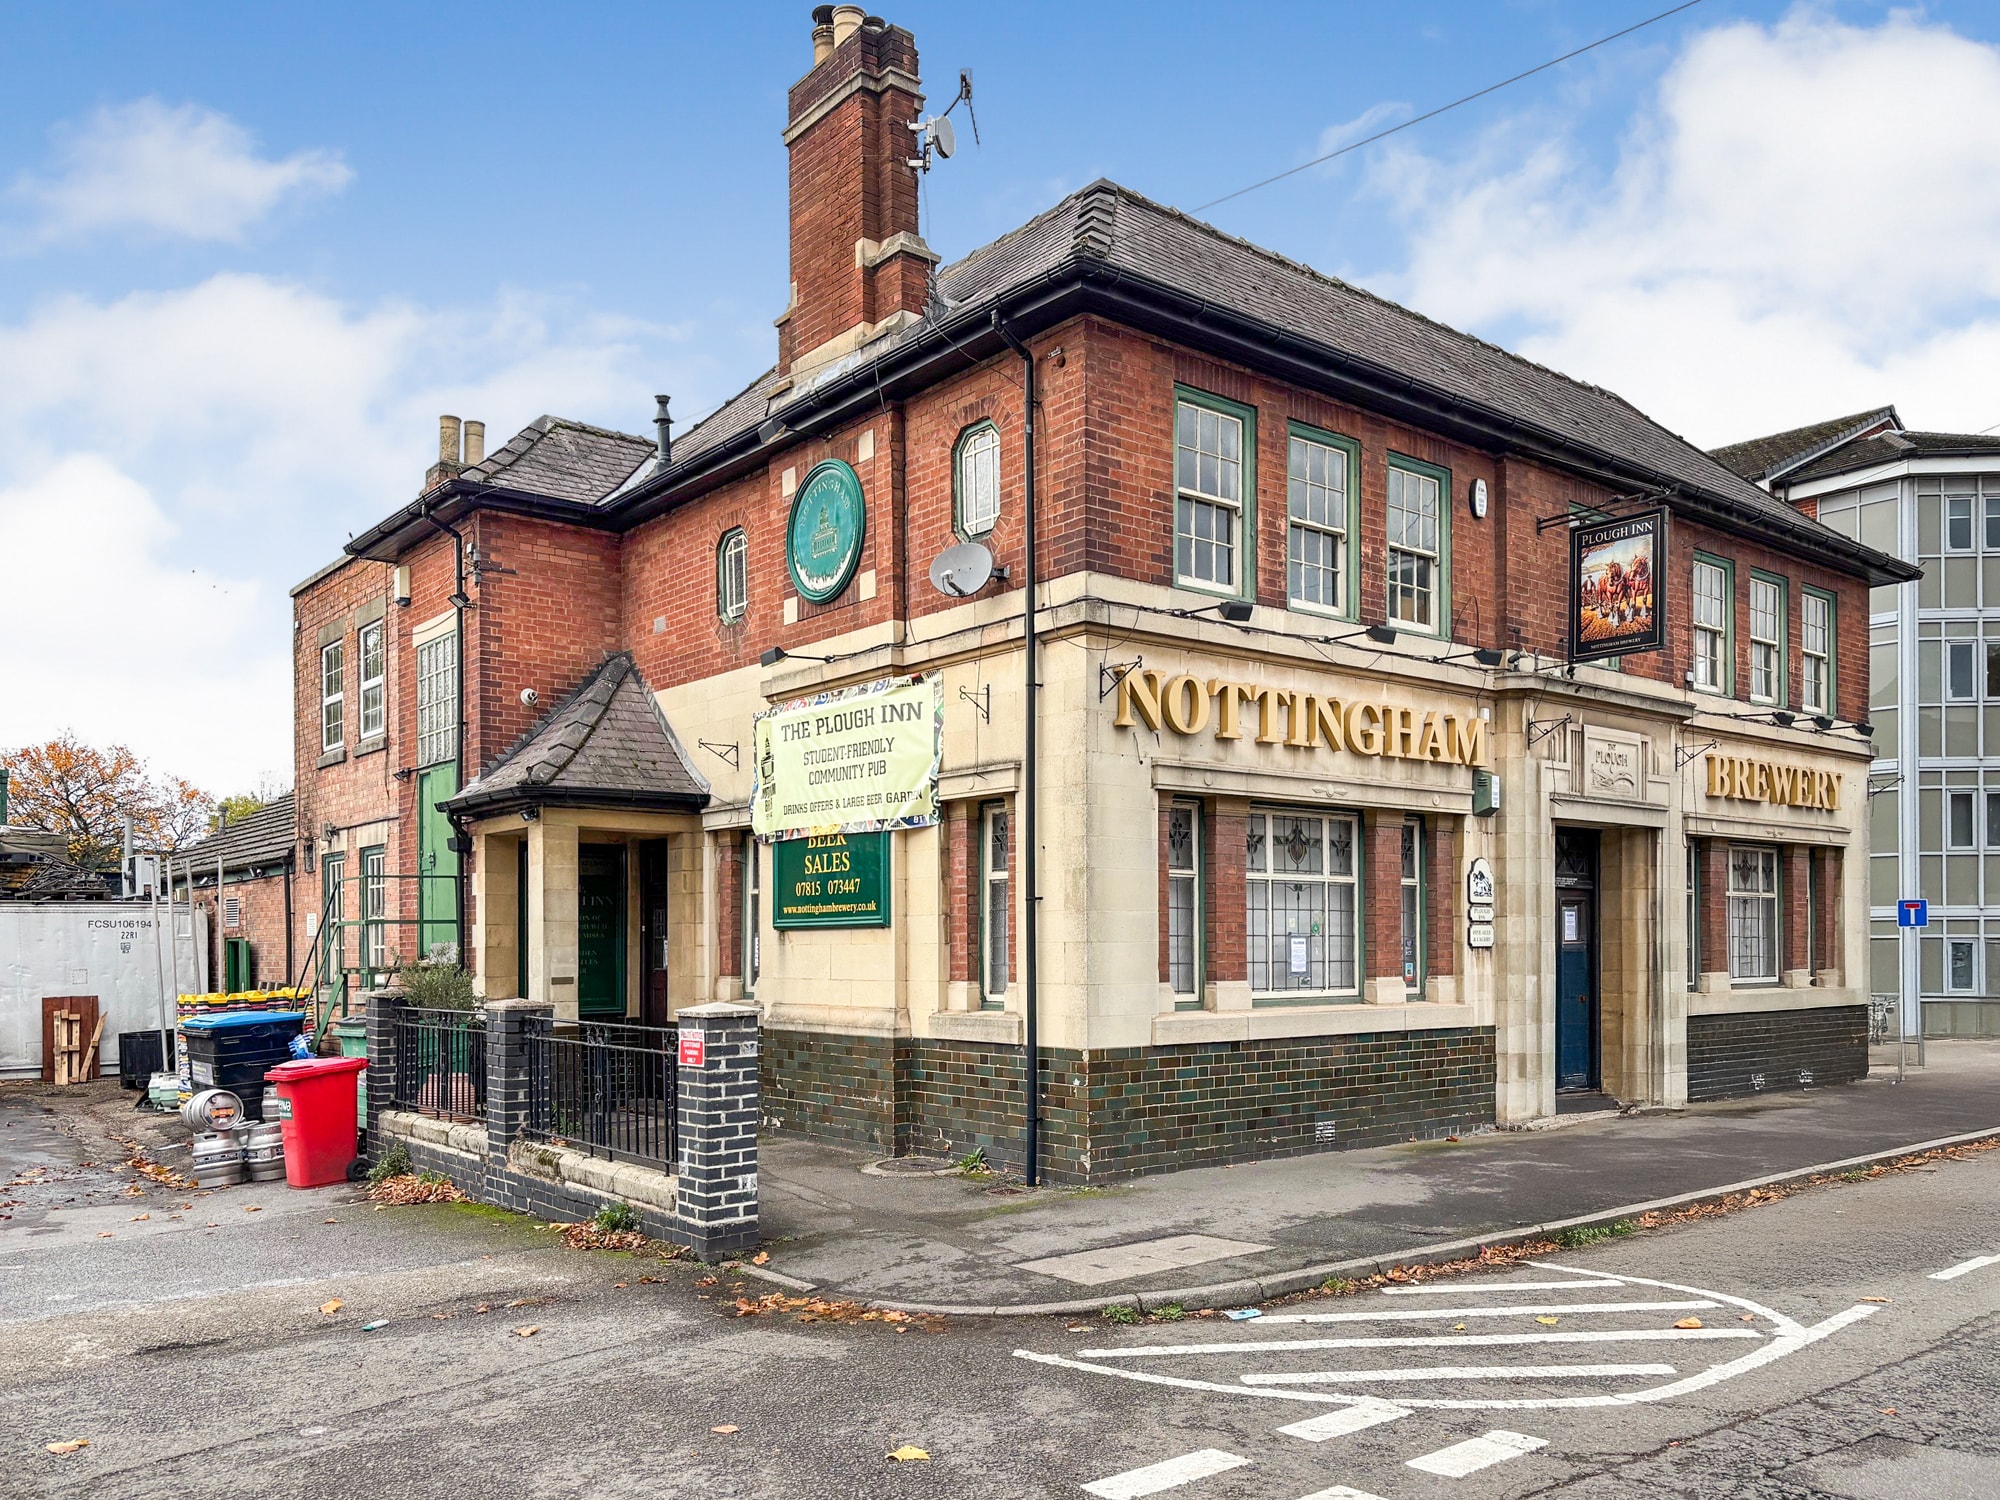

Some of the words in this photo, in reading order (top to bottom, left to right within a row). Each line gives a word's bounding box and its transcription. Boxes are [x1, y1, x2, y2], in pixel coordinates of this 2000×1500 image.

[800, 479, 850, 527] NOTTINGHAM
[1582, 527, 1628, 546] PLOUGH
[1631, 521, 1654, 535] INN
[781, 721, 811, 742] THE
[815, 707, 875, 736] PLOUGH
[881, 701, 923, 722] INN
[1113, 663, 1489, 768] NOTTINGHAM
[803, 737, 895, 766] STUDENT-FRIENDLY
[1595, 750, 1628, 767] PLOUGH
[808, 764, 865, 785] COMMUNITY
[867, 759, 886, 776] PUB
[1705, 754, 1845, 811] BREWERY
[783, 803, 808, 816] DRINKS
[809, 800, 834, 812] OFFERS
[835, 798, 841, 809] &
[842, 795, 865, 808] LARGE
[866, 793, 883, 805] BEER
[807, 834, 847, 849] BEER
[804, 851, 850, 874] SALES
[795, 880, 821, 897] 07815
[827, 878, 861, 895] 073447
[783, 900, 876, 915] www.nottinghambrewery.co.uk
[87, 920, 152, 929] FCSU106194
[121, 931, 138, 940] 22R1
